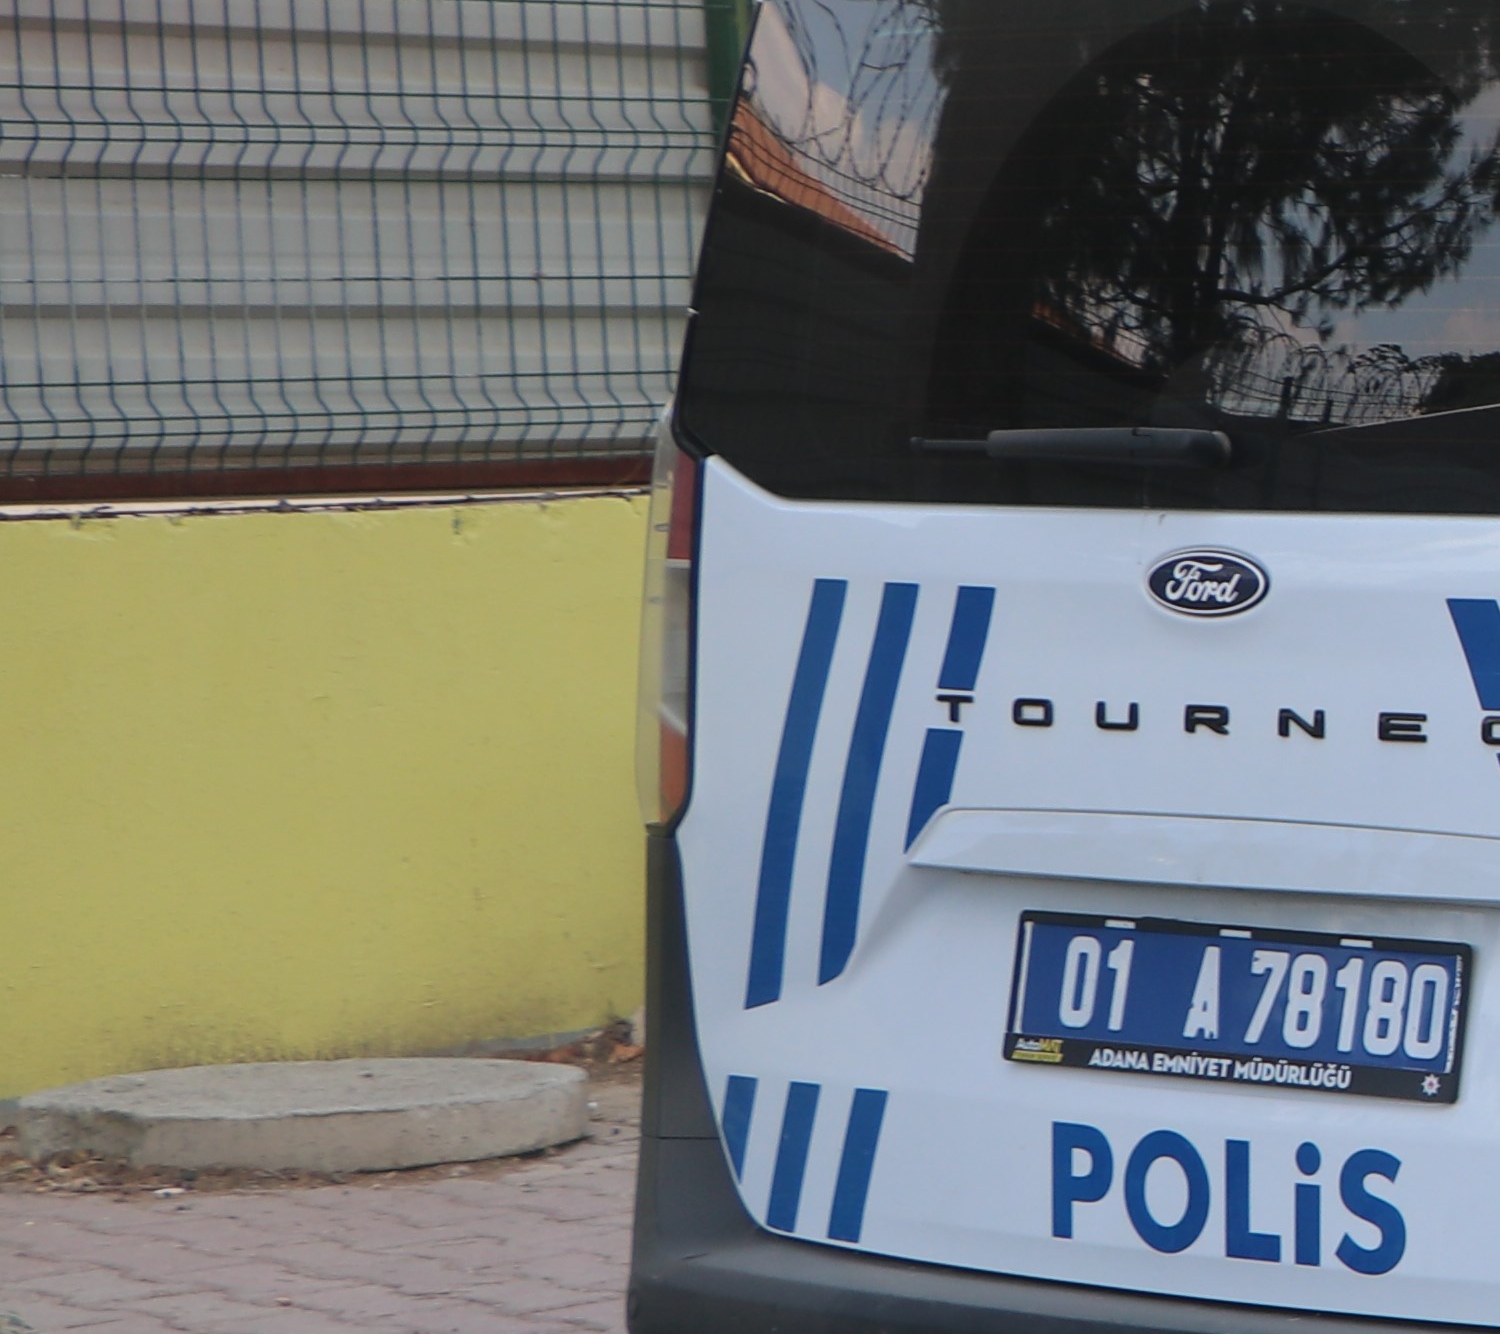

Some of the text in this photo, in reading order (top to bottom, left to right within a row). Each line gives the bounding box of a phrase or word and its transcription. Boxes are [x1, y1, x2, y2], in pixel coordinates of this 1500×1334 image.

[1165, 559, 1241, 604] Ford
[1058, 935, 1449, 1060] 01 A 78180
[1087, 1048, 1150, 1071] ADANA
[1151, 1052, 1233, 1079] EMNİYET
[1233, 1057, 1353, 1089] MÜDÜRLÜĞÜ
